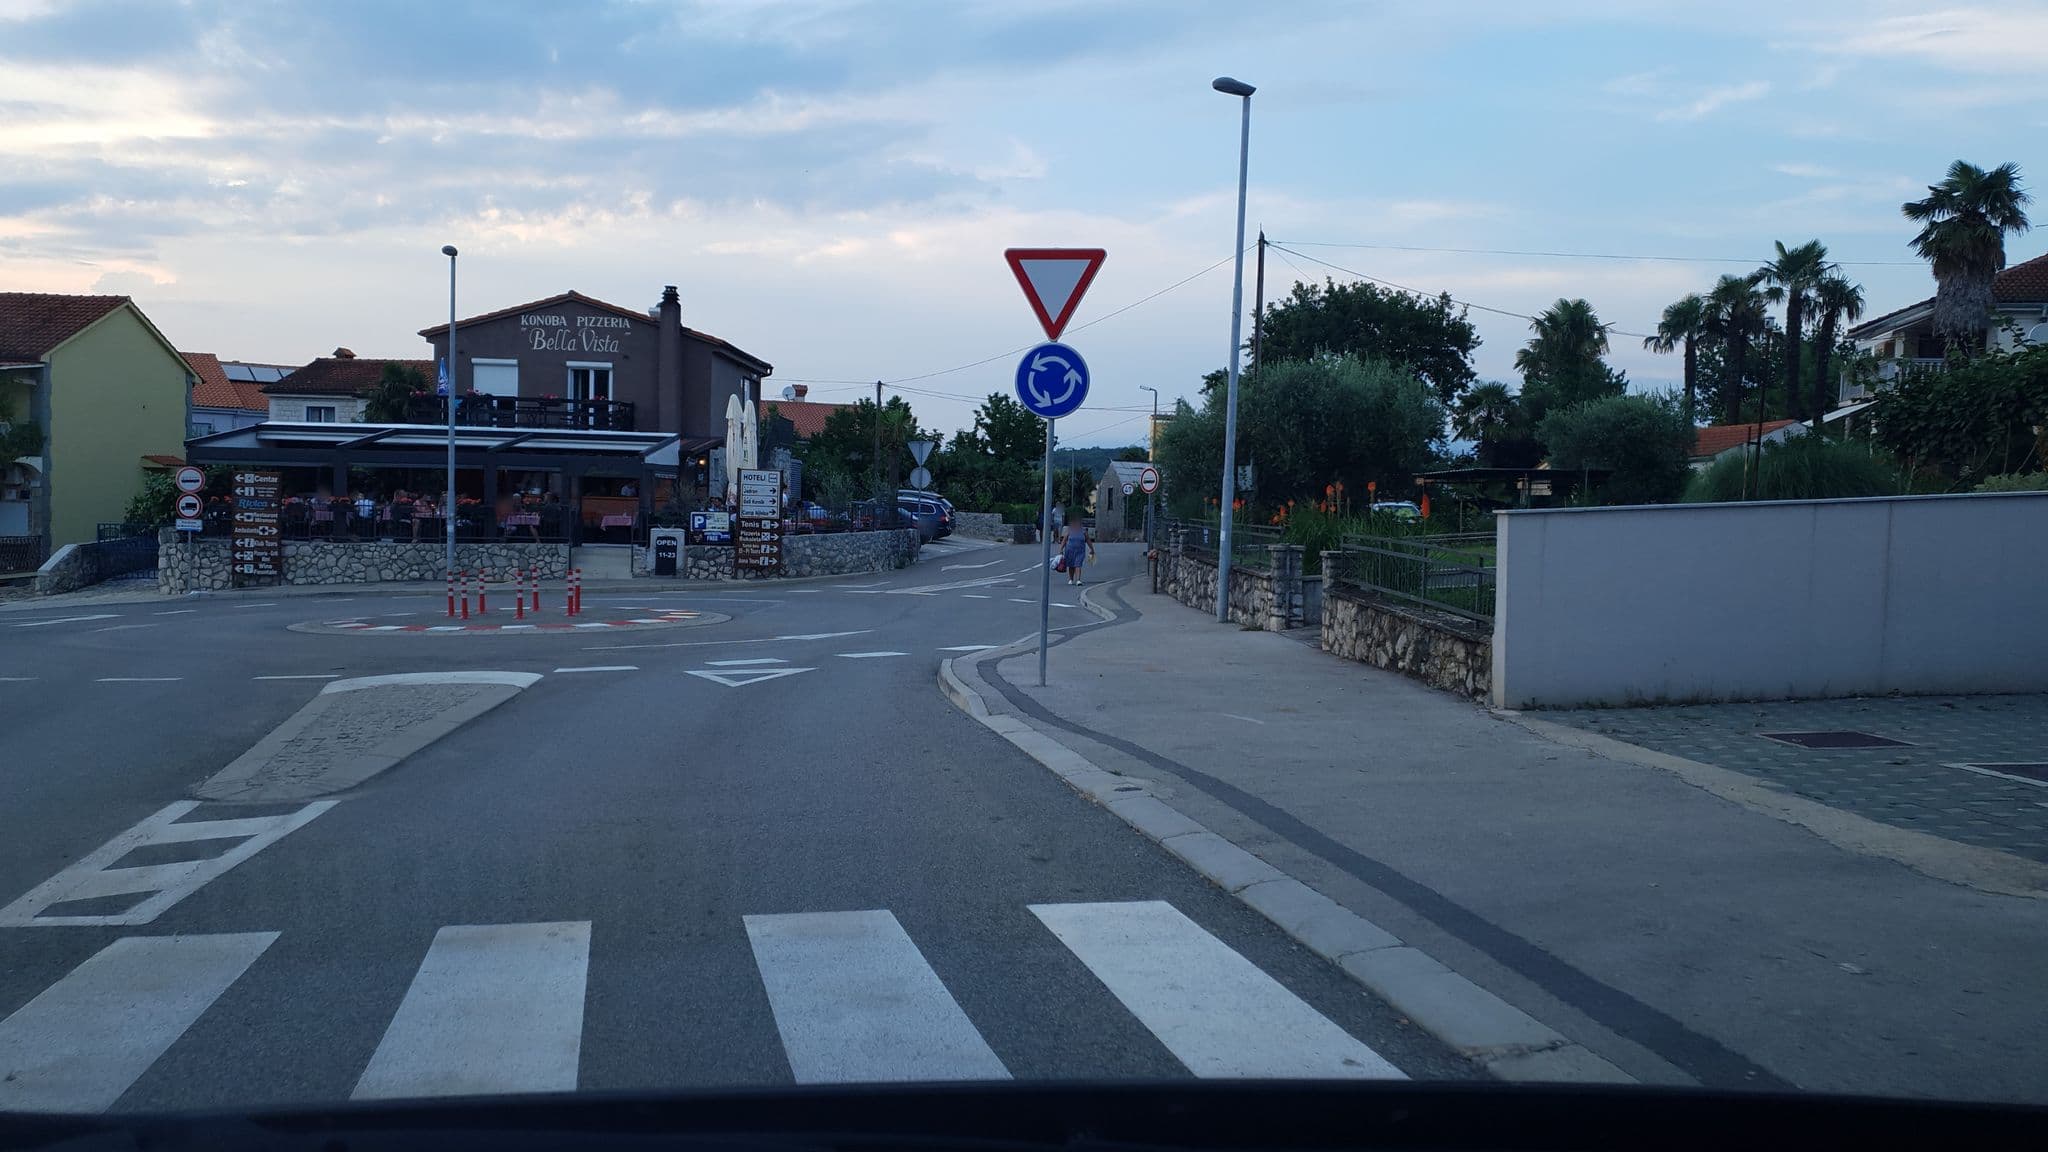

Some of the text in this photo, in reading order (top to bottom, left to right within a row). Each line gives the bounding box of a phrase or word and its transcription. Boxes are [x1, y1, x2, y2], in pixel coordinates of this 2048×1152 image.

[521, 315, 631, 328] KONOBA PIZZERIA
[254, 475, 278, 483] Centar
[741, 520, 760, 528] Tenis
